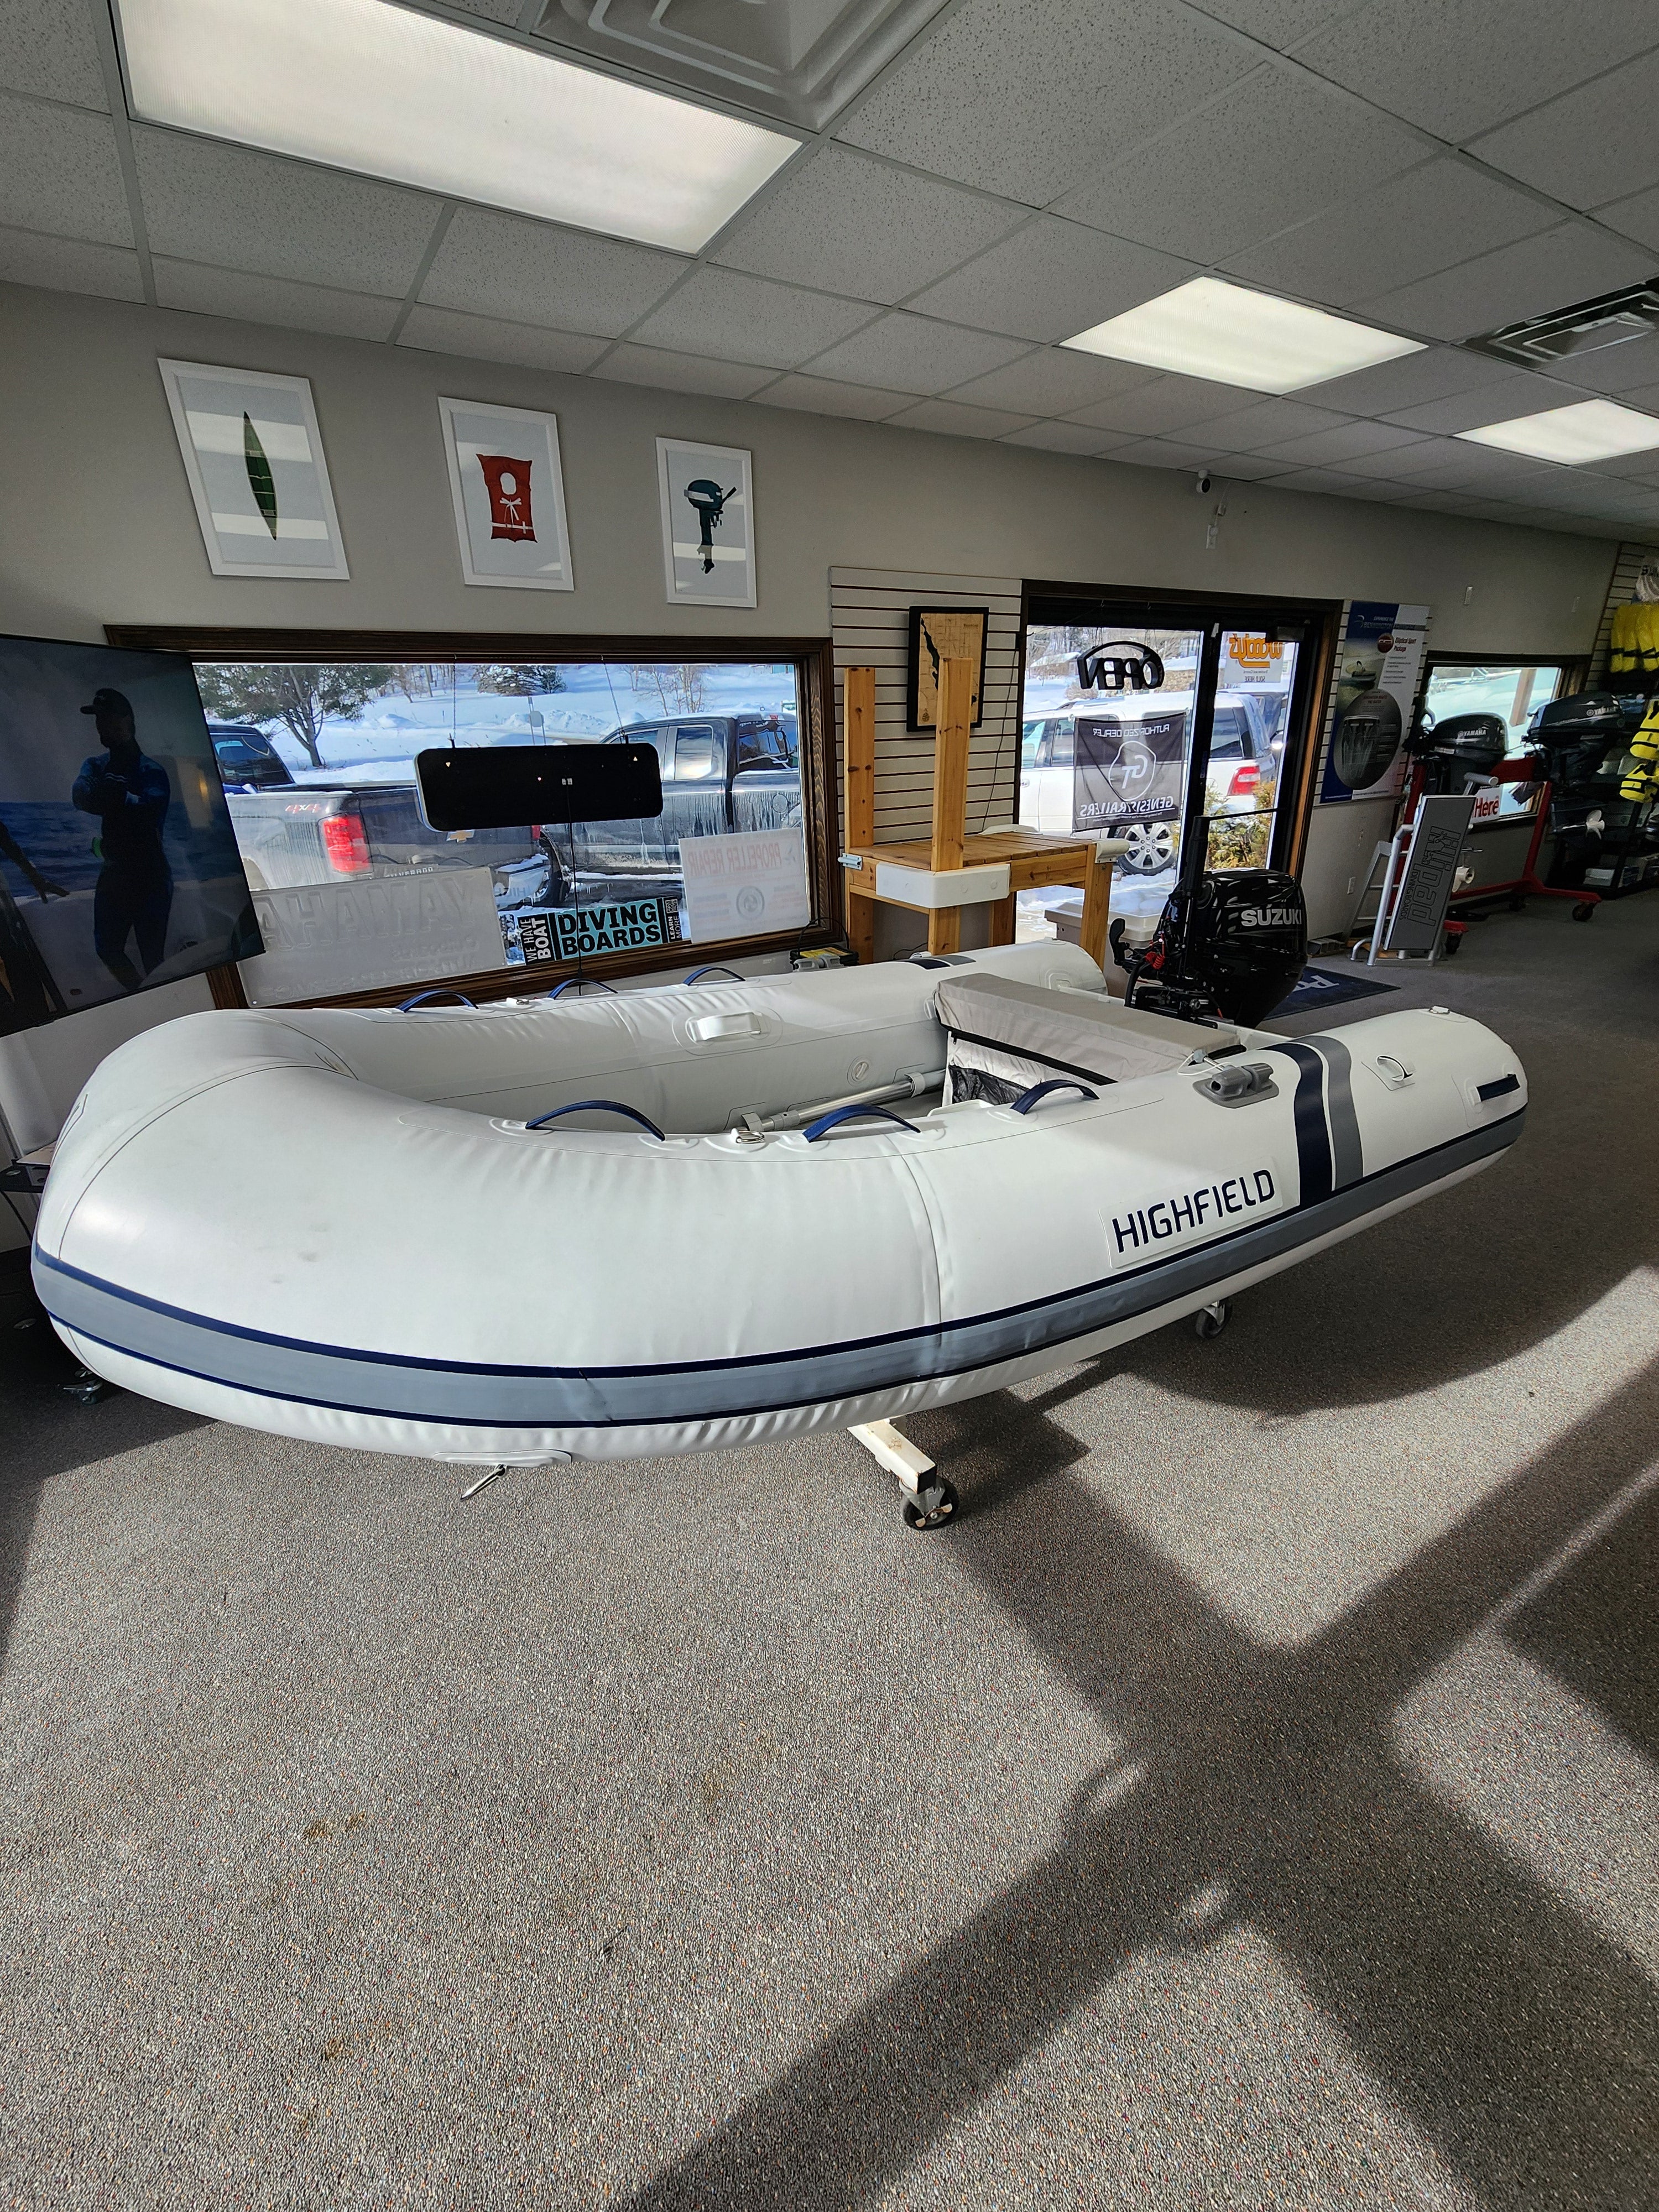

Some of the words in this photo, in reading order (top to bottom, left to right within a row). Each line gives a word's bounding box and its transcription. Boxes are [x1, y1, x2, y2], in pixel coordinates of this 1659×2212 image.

[285, 803, 321, 815] 4x4
[1474, 797, 1499, 818] Here
[385, 867, 434, 878] VERADO
[1405, 870, 1418, 895] DIVING
[557, 902, 658, 936] DIVING
[1241, 908, 1302, 927] SUZUKI
[1399, 895, 1412, 920] BOARDS
[521, 917, 533, 945] HAVE
[531, 917, 551, 960] BOAT
[674, 915, 682, 938] MORE
[561, 924, 661, 956] BOARDS
[527, 948, 538, 963] WE
[1112, 1169, 1275, 1254] HIGHFIELD
